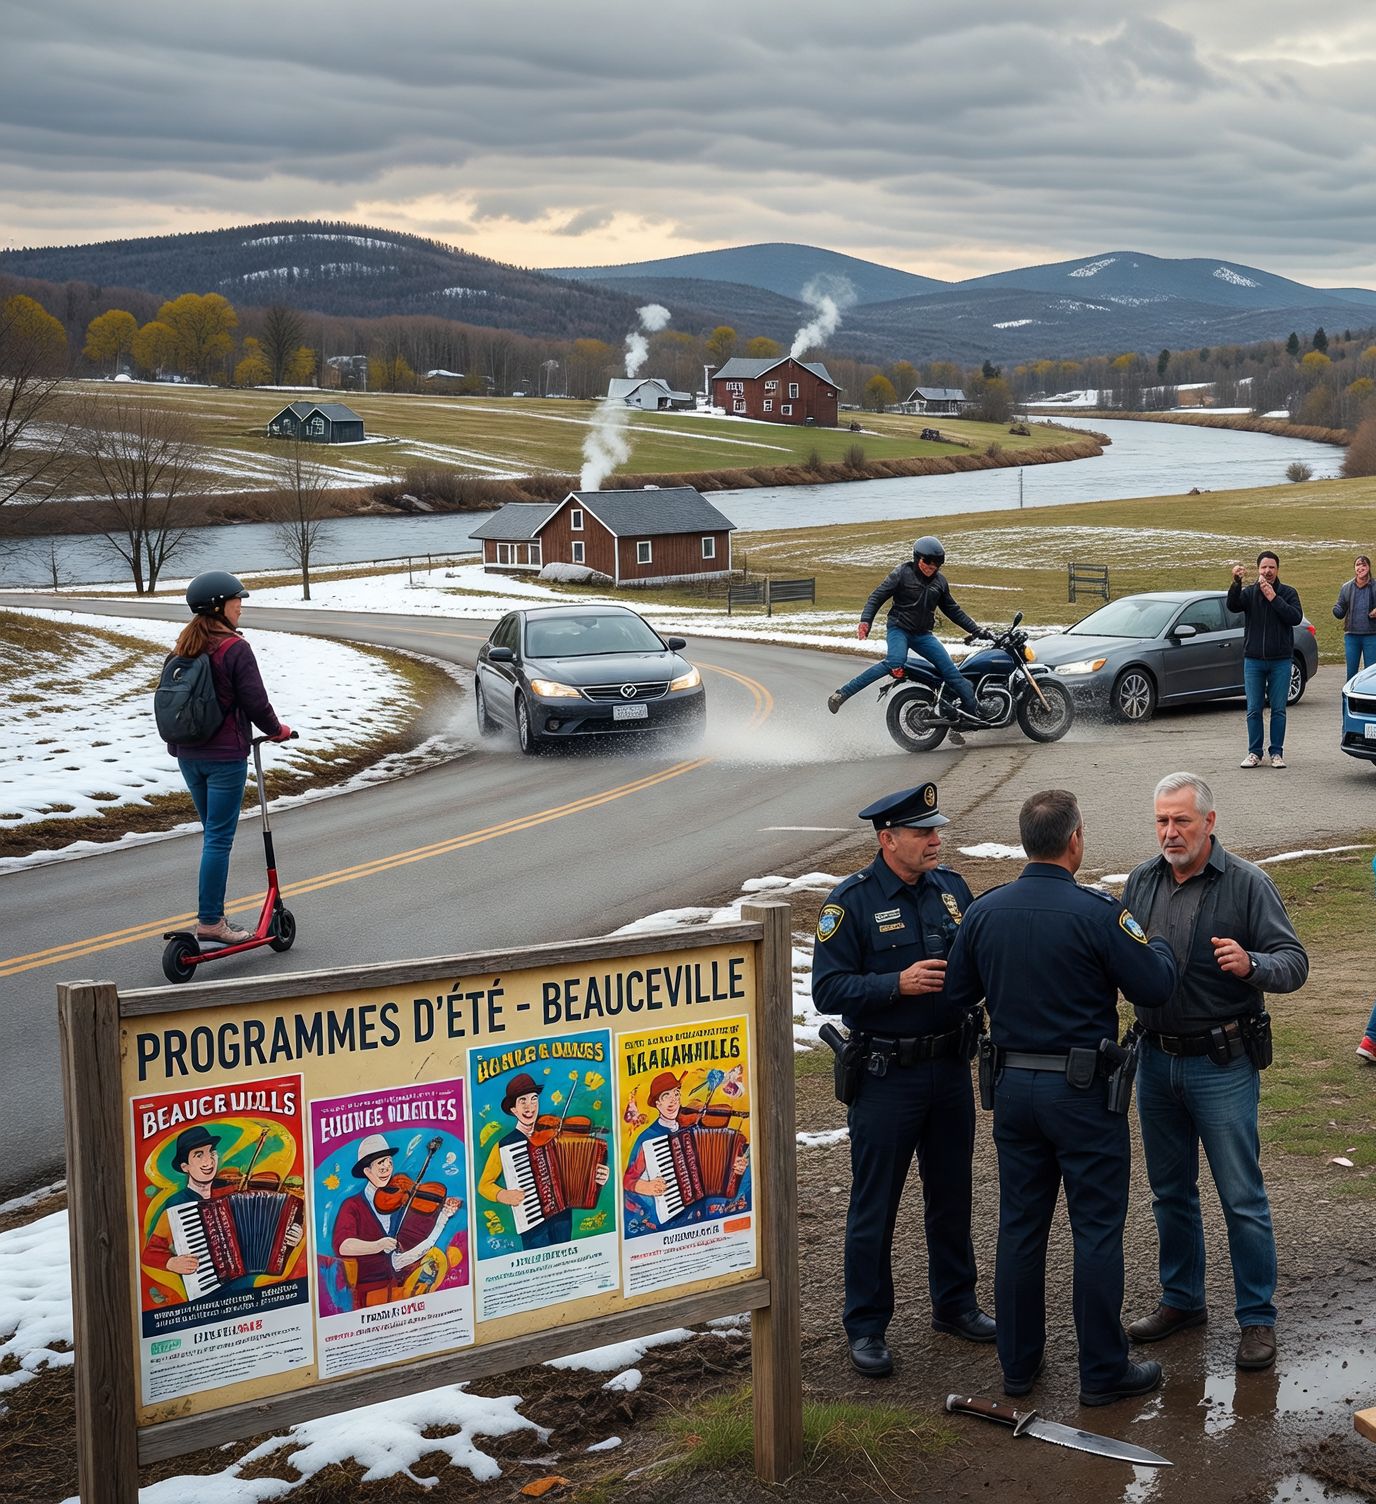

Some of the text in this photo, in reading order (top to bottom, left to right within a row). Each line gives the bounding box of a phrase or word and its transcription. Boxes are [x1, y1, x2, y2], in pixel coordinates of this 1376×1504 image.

[135, 1002, 401, 1082] PROGRAMMES
[413, 978, 506, 1043] D'ÉTÉ
[542, 957, 745, 1025] BEAUCEVILLE
